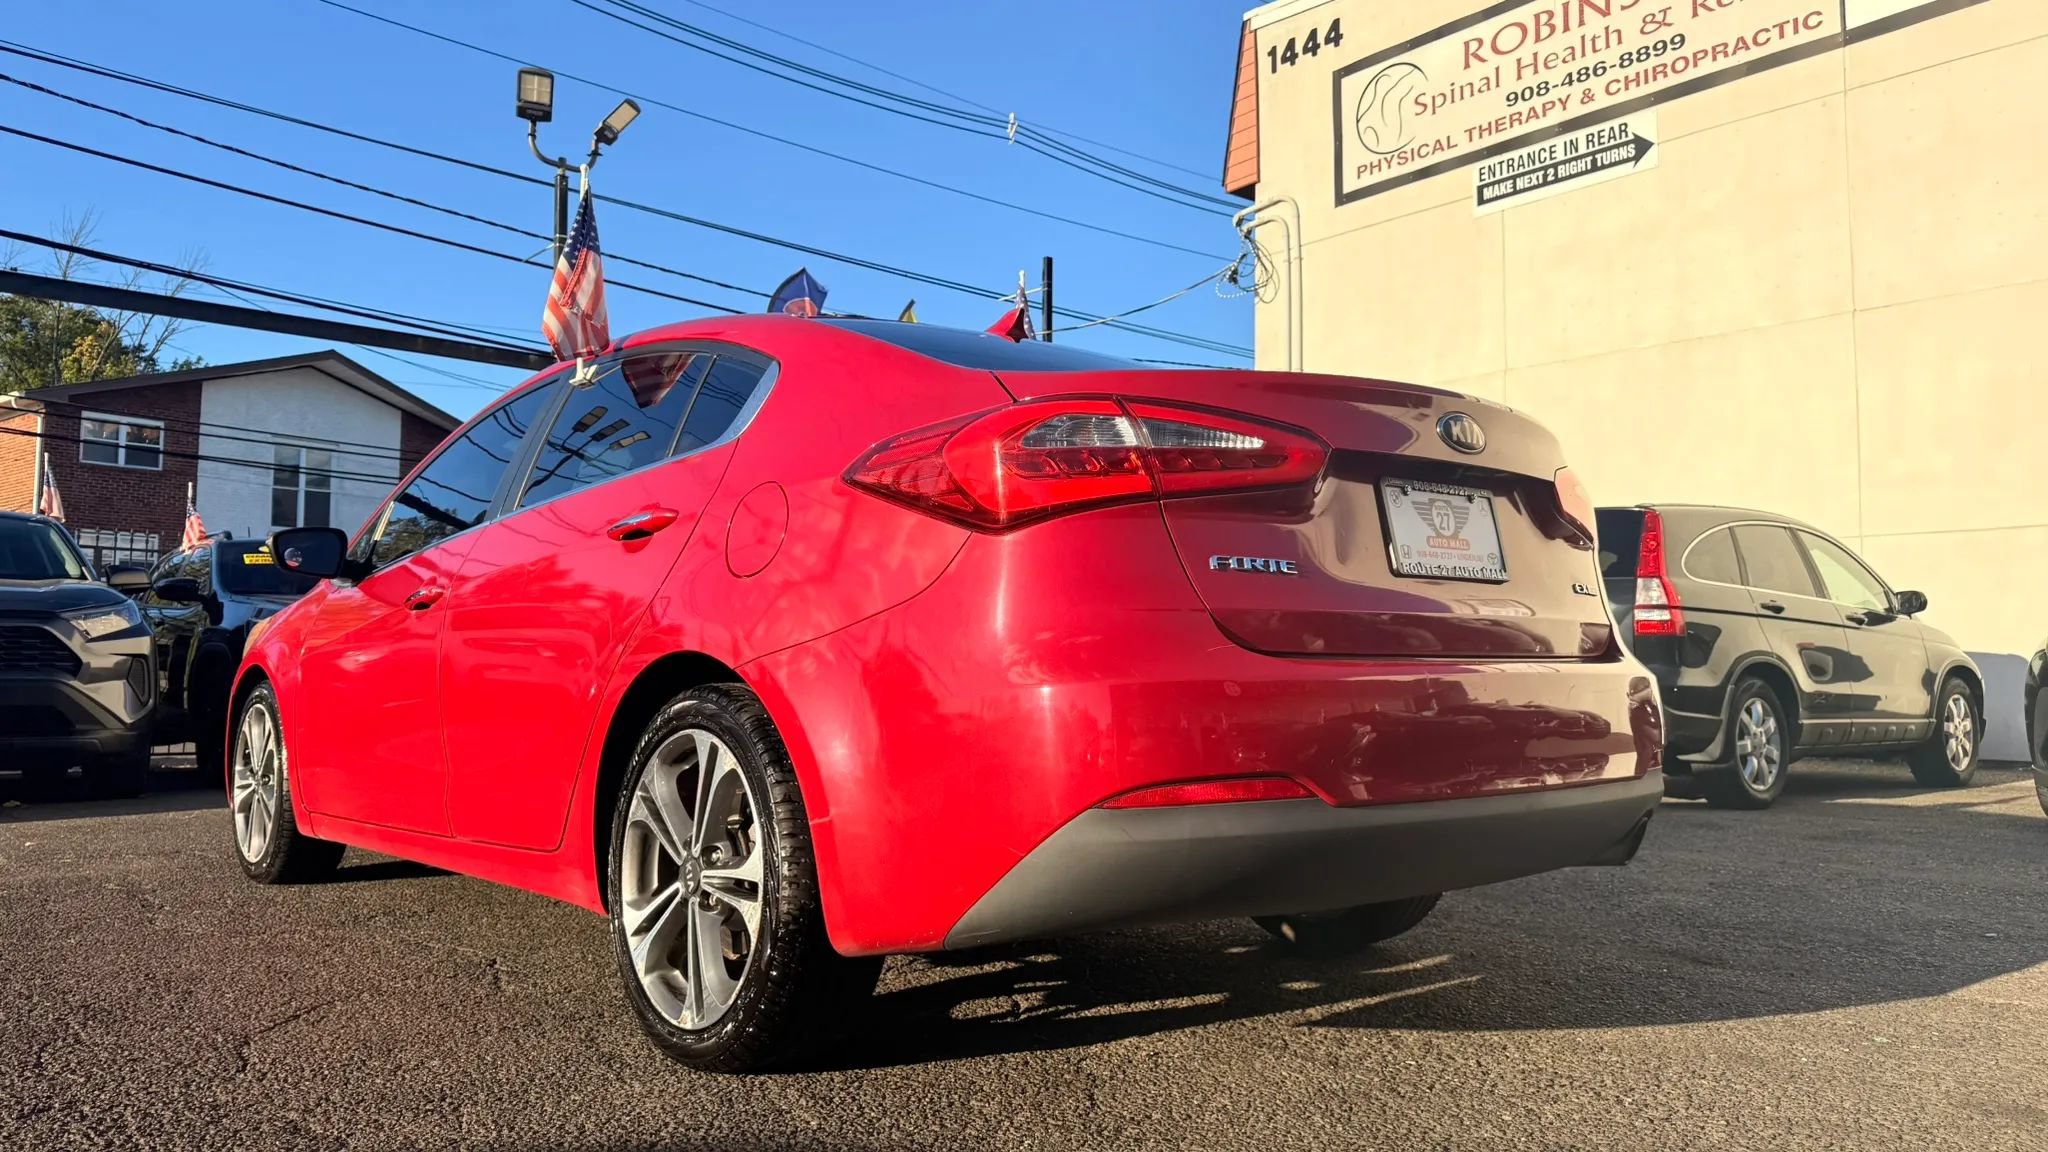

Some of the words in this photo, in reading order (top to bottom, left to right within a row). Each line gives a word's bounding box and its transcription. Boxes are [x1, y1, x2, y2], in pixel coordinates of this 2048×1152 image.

[1267, 18, 1344, 74] 1444
[1414, 66, 1501, 116] Spinal
[1515, 25, 1624, 82] Health
[1639, 6, 1674, 35] &
[1505, 33, 1687, 108] 908-486-8899
[1357, 135, 1459, 180] PHYSICAL
[1463, 93, 1572, 144] THERAPY
[1580, 88, 1596, 105] &
[1604, 10, 1824, 96] CHIROPRACTIC
[1479, 144, 1558, 183] ENTRANCE
[1563, 137, 1579, 157] IN
[1586, 122, 1630, 150] REAR
[1482, 179, 1514, 201] MAKE
[1516, 171, 1545, 190] NEXT
[1546, 168, 1555, 182] 2
[1557, 157, 1594, 179] RIGHT
[1595, 143, 1636, 167] TURNS
[1449, 418, 1484, 446] KIA
[1436, 511, 1451, 531] 27
[1209, 555, 1298, 574] FORTE
[1402, 562, 1439, 575] ROUTE
[1455, 566, 1481, 577] AUTO
[1482, 568, 1507, 579] MALL
